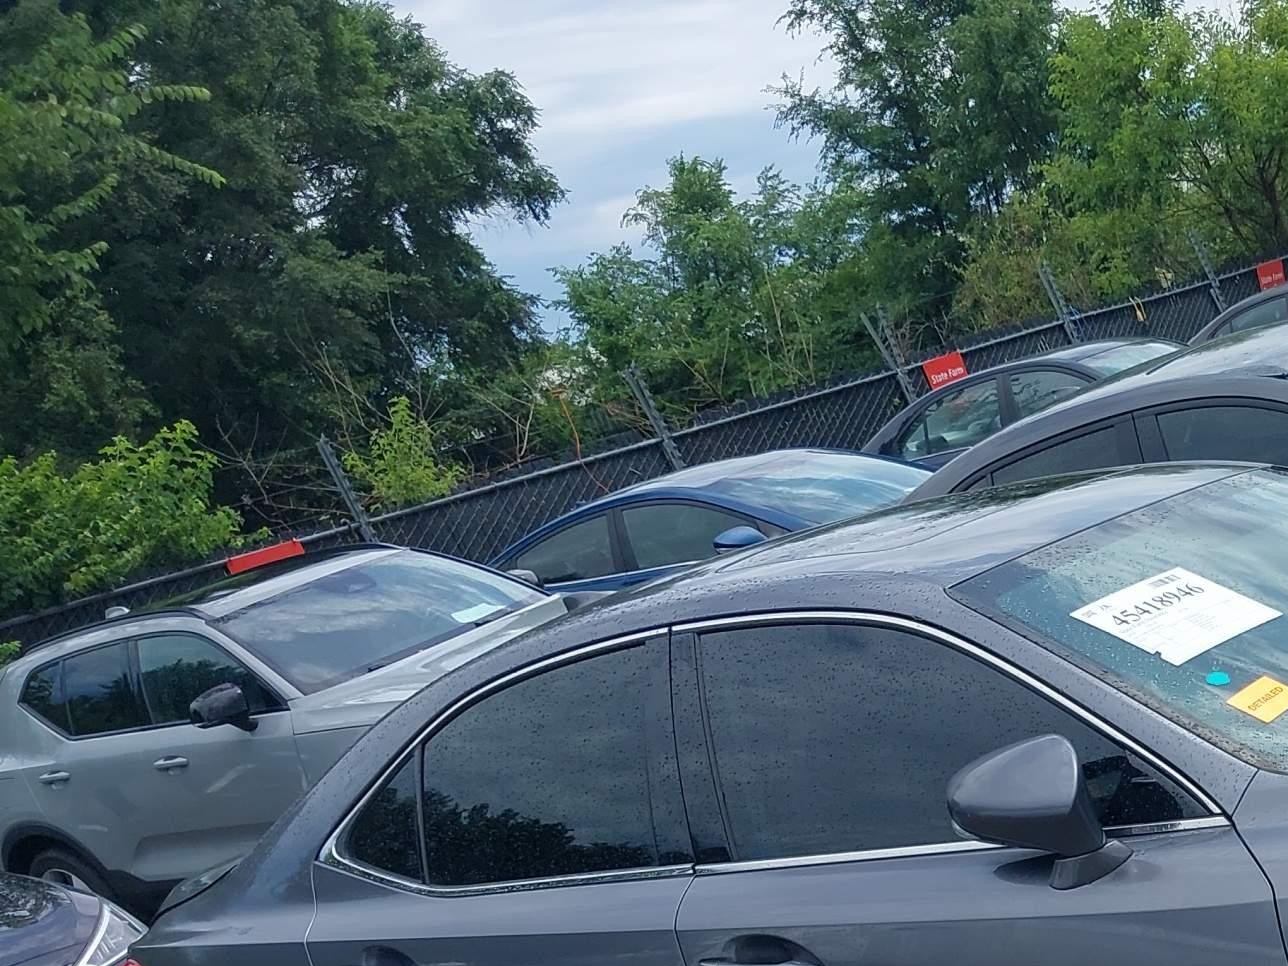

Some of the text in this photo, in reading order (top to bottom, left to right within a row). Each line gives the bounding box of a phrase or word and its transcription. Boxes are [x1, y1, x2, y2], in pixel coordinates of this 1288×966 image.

[931, 367, 964, 385] State Farm
[1112, 584, 1205, 626] 45418946
[1247, 686, 1284, 712] DETAILED
